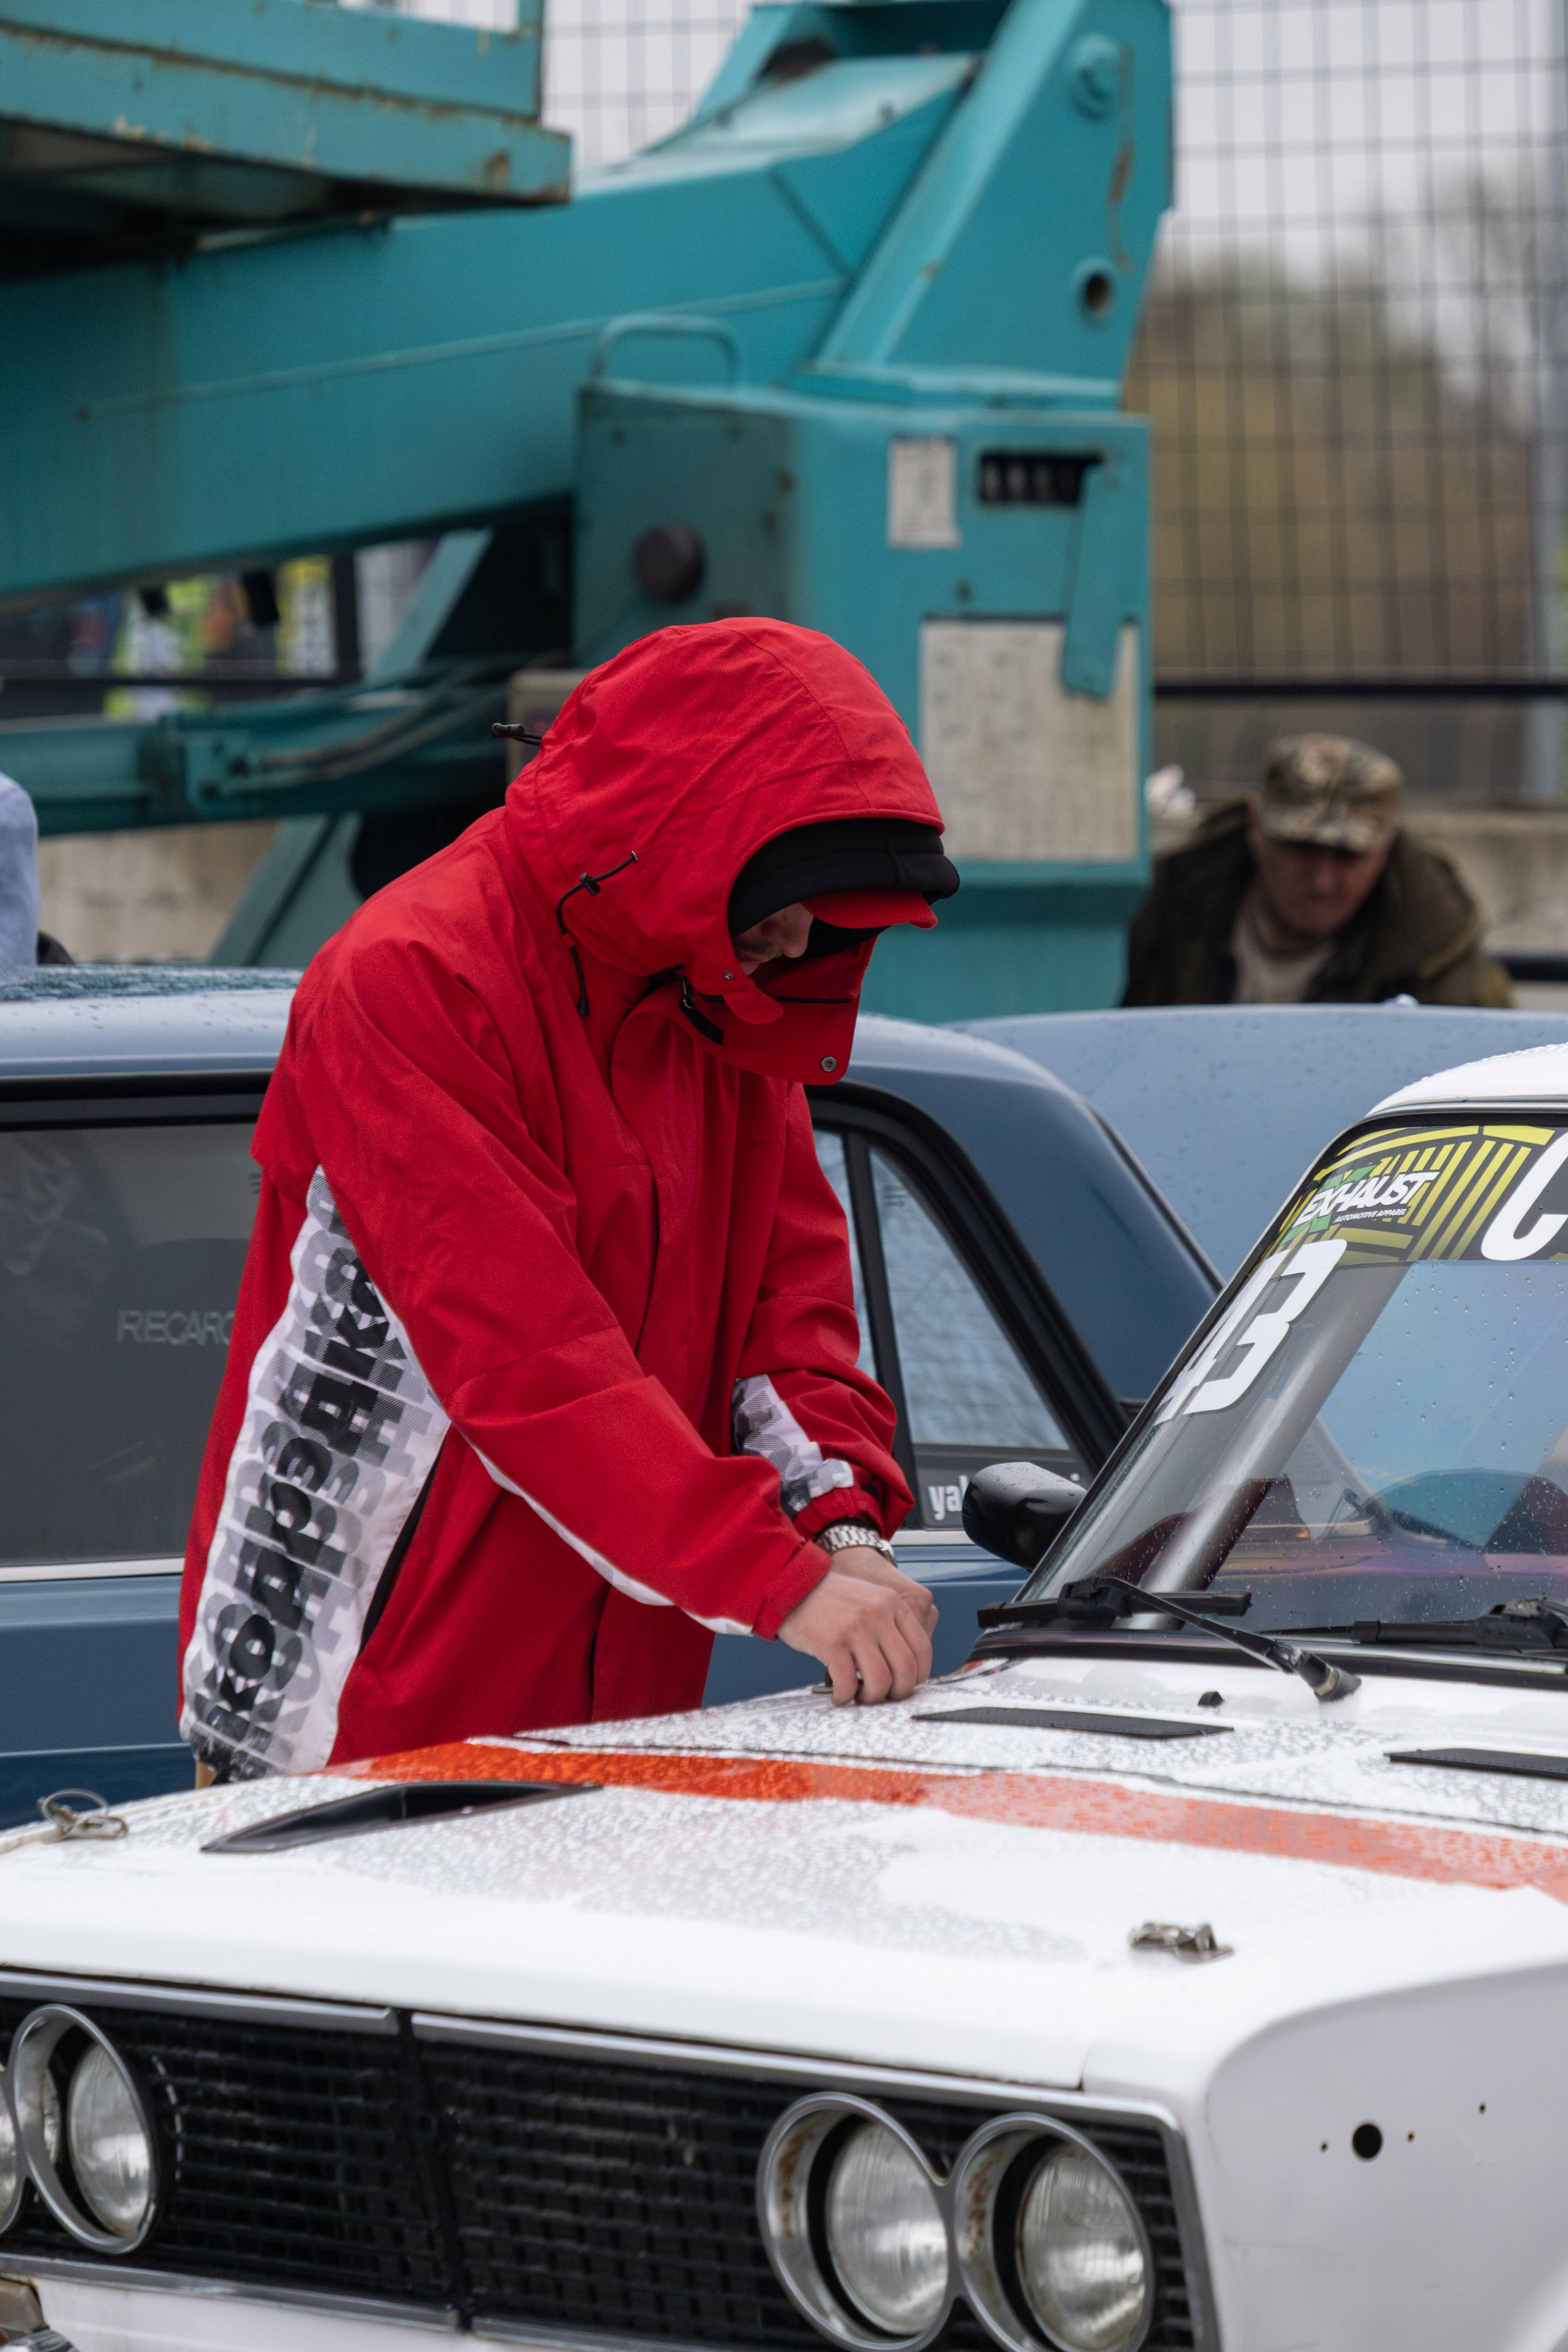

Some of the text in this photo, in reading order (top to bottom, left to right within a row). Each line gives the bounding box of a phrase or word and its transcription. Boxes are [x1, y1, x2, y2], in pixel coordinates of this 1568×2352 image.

[1291, 1172, 1440, 1229] EXHAUST
[1334, 1208, 1408, 1223] AUTOMOTIVE APPAREL
